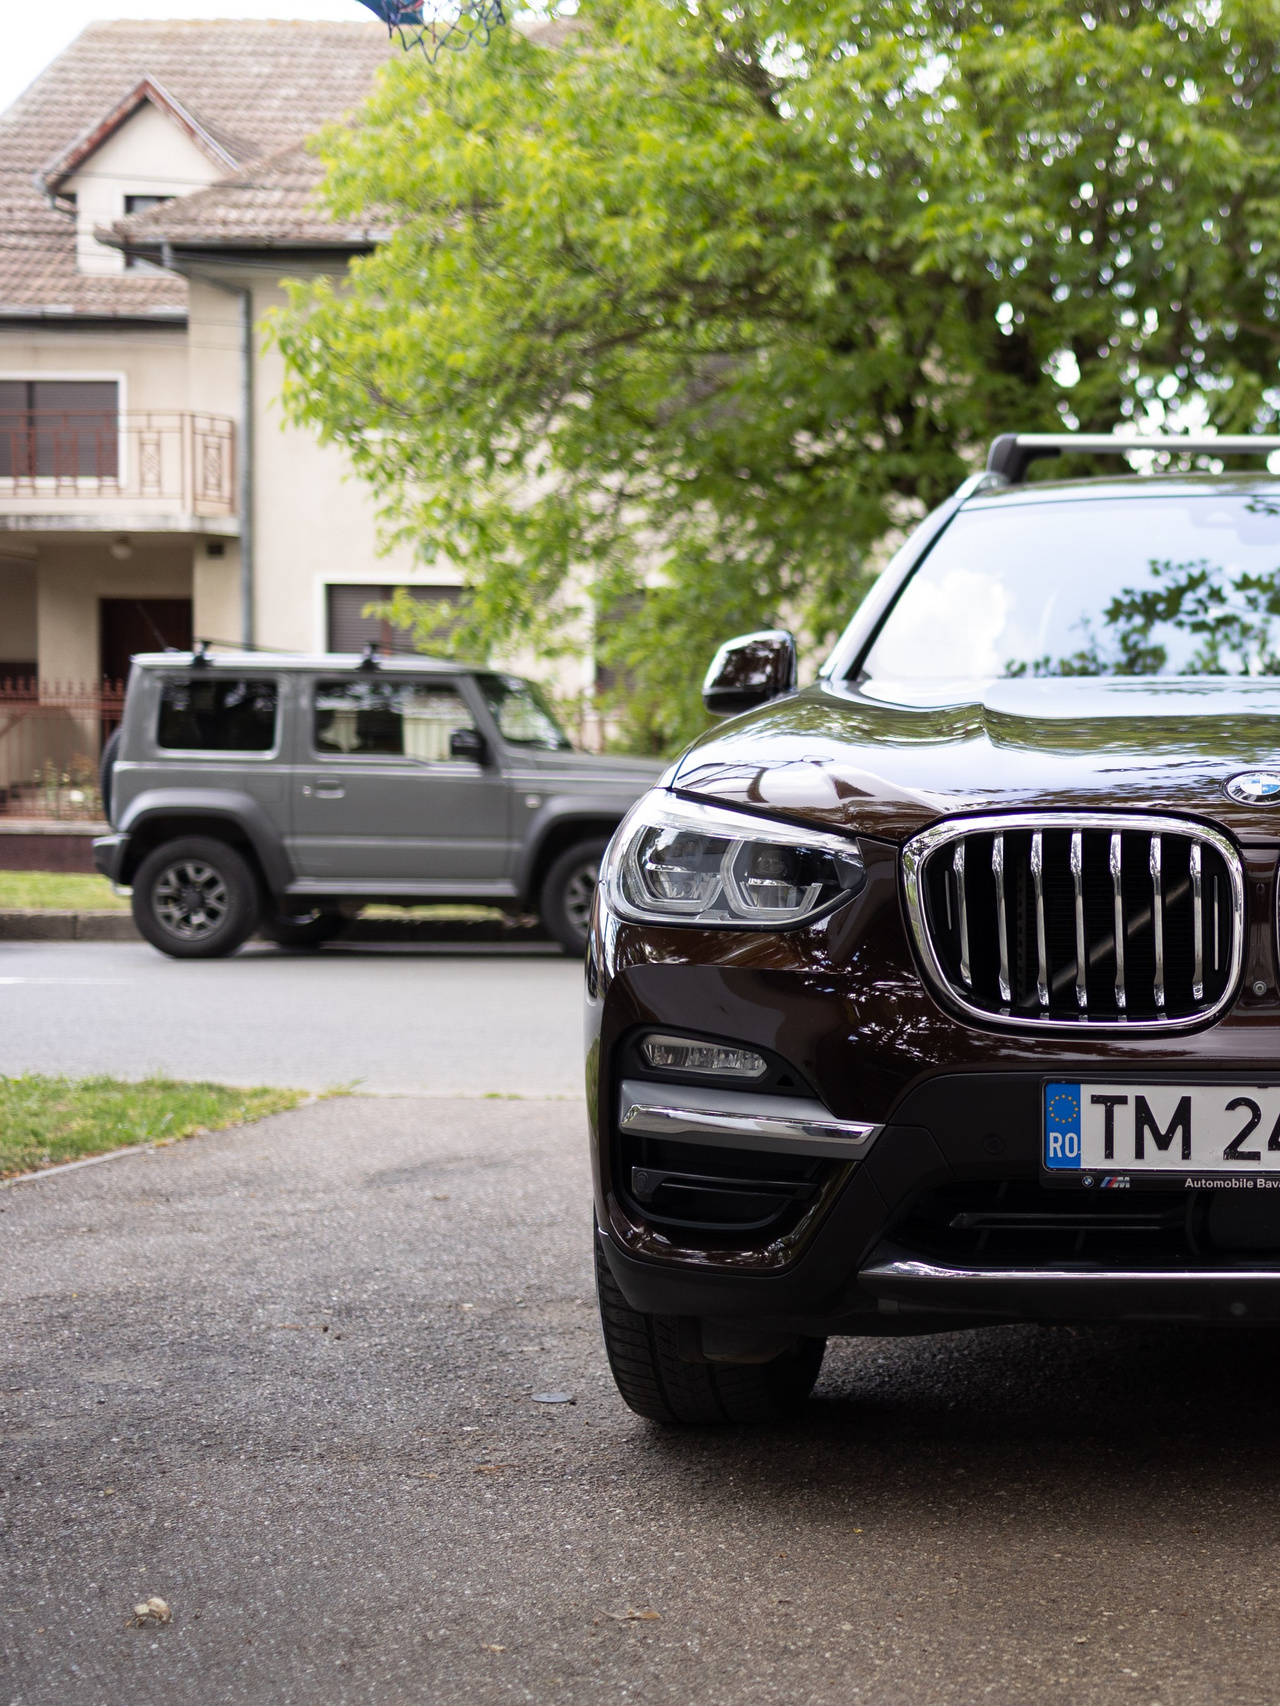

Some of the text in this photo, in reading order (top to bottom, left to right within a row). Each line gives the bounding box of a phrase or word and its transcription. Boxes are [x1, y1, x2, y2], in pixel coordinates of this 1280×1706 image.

[1090, 1094, 1192, 1160] TM
[1050, 1132, 1079, 1158] RO
[1184, 1178, 1254, 1189] Automobile
